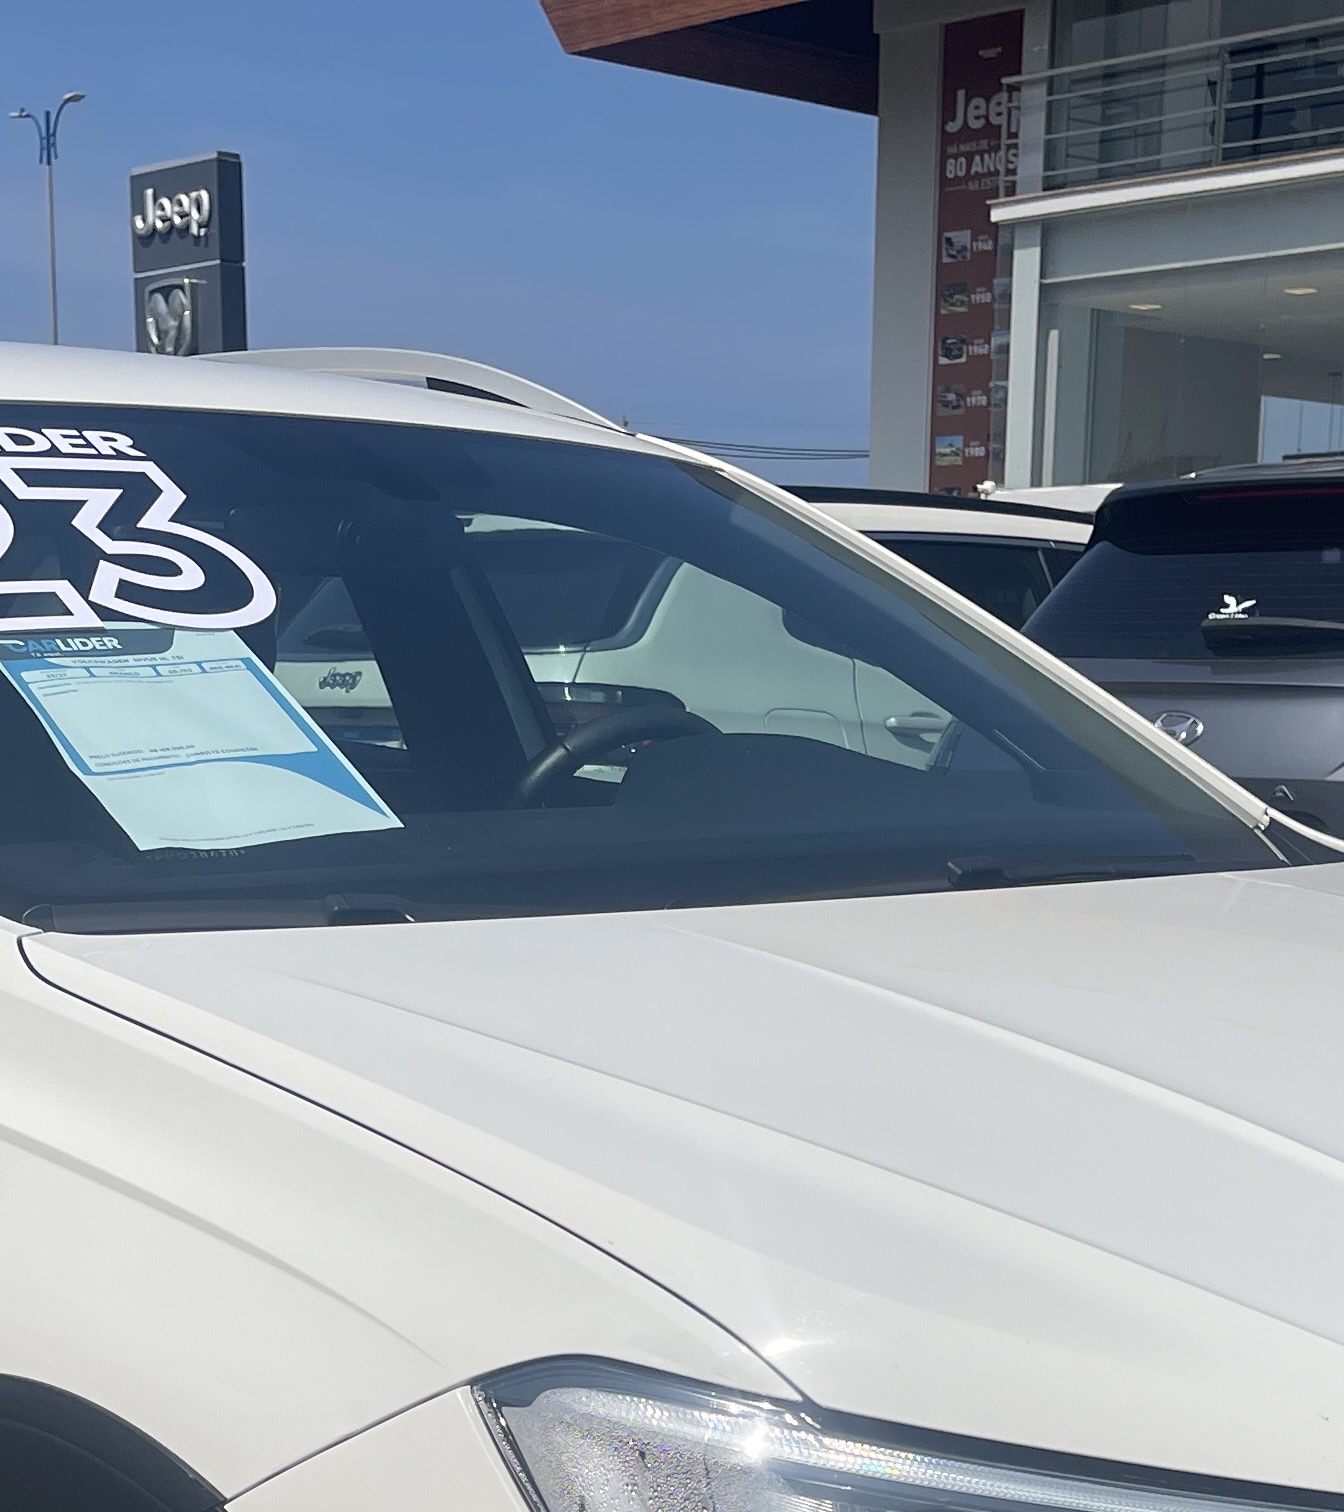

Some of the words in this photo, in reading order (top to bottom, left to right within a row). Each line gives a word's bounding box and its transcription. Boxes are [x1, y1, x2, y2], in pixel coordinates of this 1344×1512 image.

[946, 156, 966, 178] 80
[970, 148, 1018, 175] ANOS
[133, 188, 210, 237] Jeep
